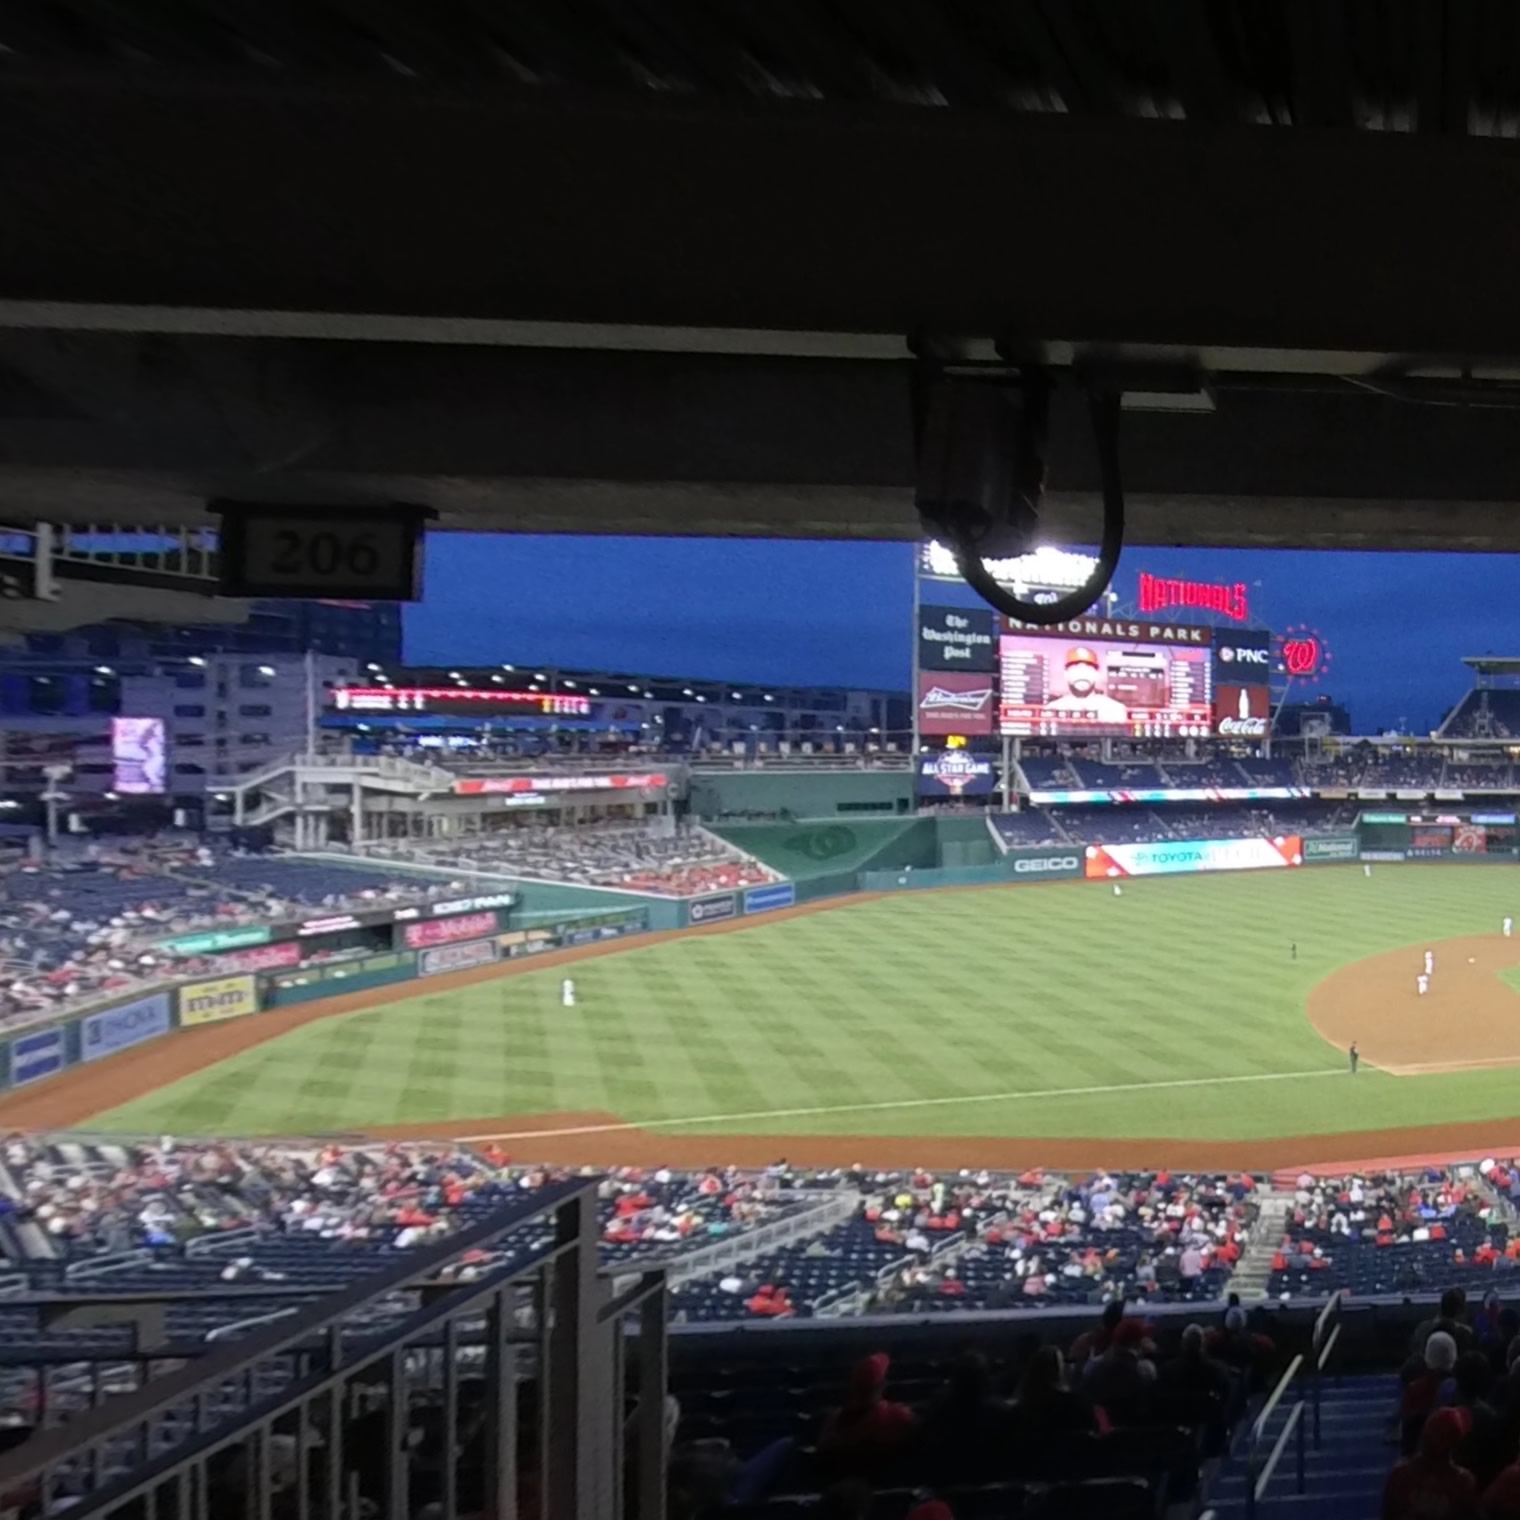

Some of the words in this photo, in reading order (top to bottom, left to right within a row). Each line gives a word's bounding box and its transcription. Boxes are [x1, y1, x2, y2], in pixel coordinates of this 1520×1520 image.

[272, 530, 379, 575] 206
[1139, 573, 1248, 621] NATIONALS
[945, 614, 969, 628] The
[922, 627, 991, 645] Washington
[1150, 626, 1202, 641] PARK
[944, 646, 971, 660] Post
[1236, 648, 1268, 663] PNC
[1283, 637, 1316, 674] W
[1014, 856, 1079, 872] GEICO
[1151, 852, 1202, 864] TOYOTA
